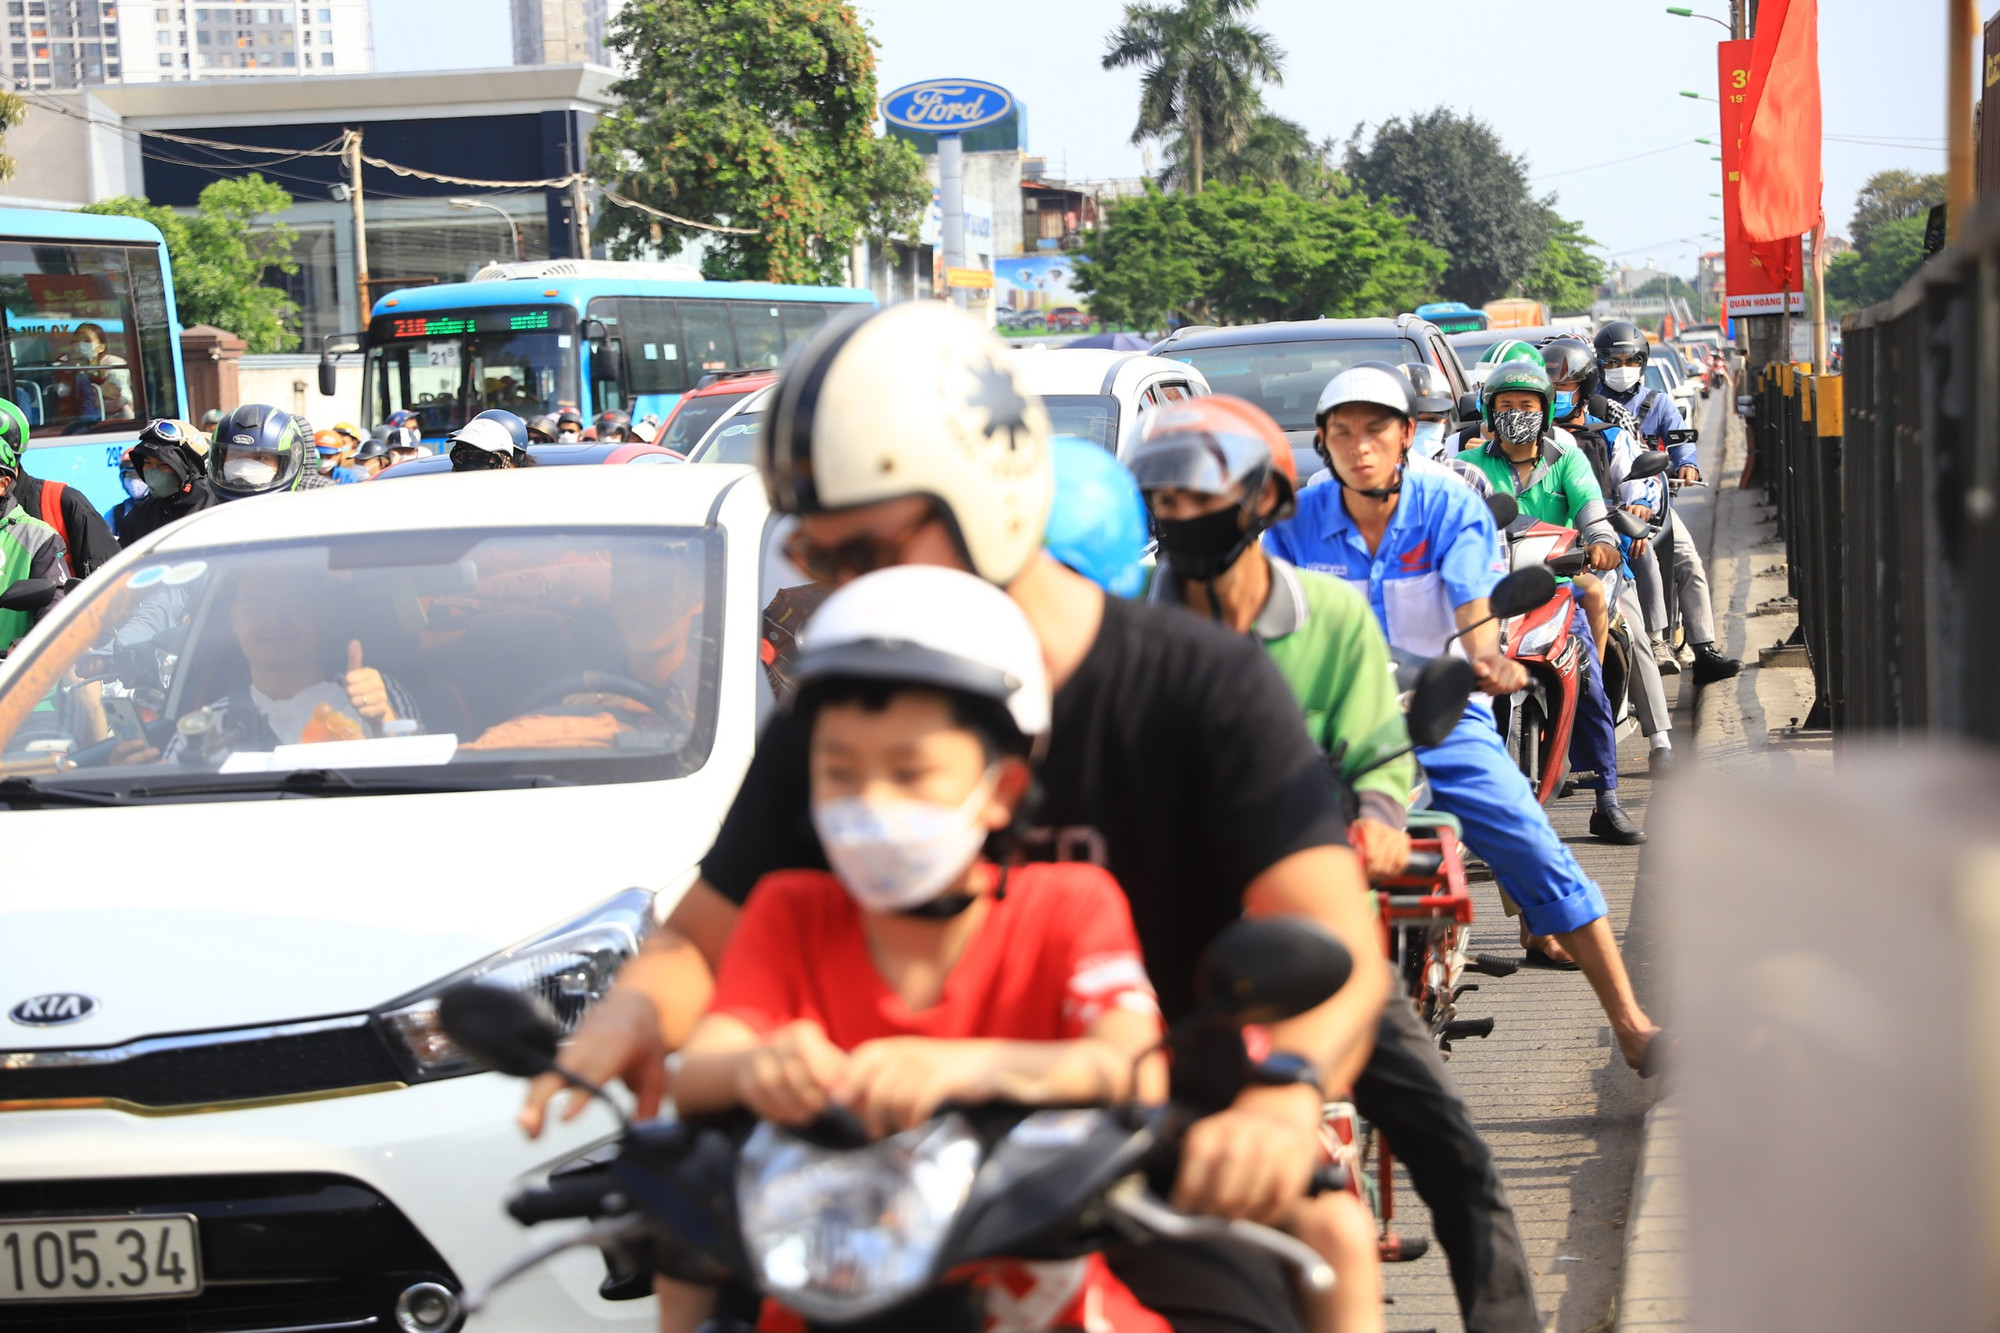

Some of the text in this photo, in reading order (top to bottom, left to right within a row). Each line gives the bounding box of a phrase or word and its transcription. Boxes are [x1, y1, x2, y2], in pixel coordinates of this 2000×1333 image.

[1731, 69, 1751, 89] 3
[906, 87, 986, 123] Ford
[1729, 93, 1747, 104] 19
[21, 996, 84, 1019] KIA
[4, 1226, 187, 1292] 105.34
